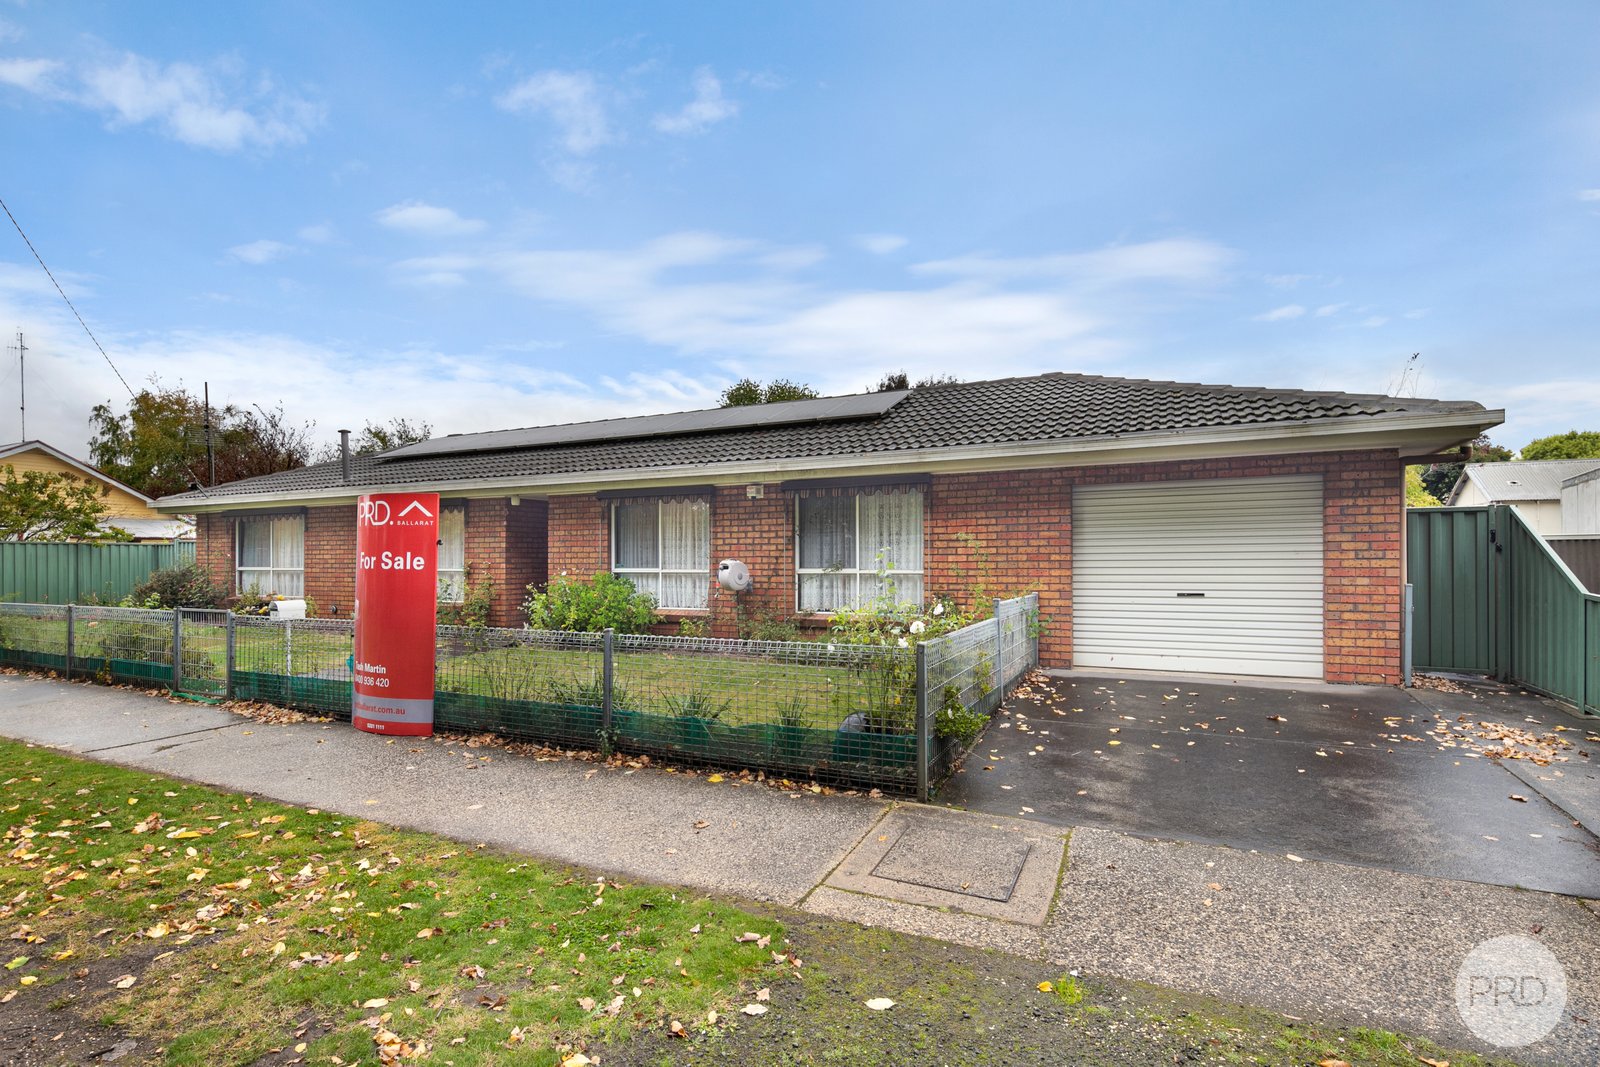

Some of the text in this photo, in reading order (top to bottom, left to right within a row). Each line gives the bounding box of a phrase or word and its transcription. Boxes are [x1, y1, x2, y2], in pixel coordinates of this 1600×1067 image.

[360, 551, 425, 570] For Sale
[364, 663, 387, 674] Martin
[375, 678, 390, 688] 420
